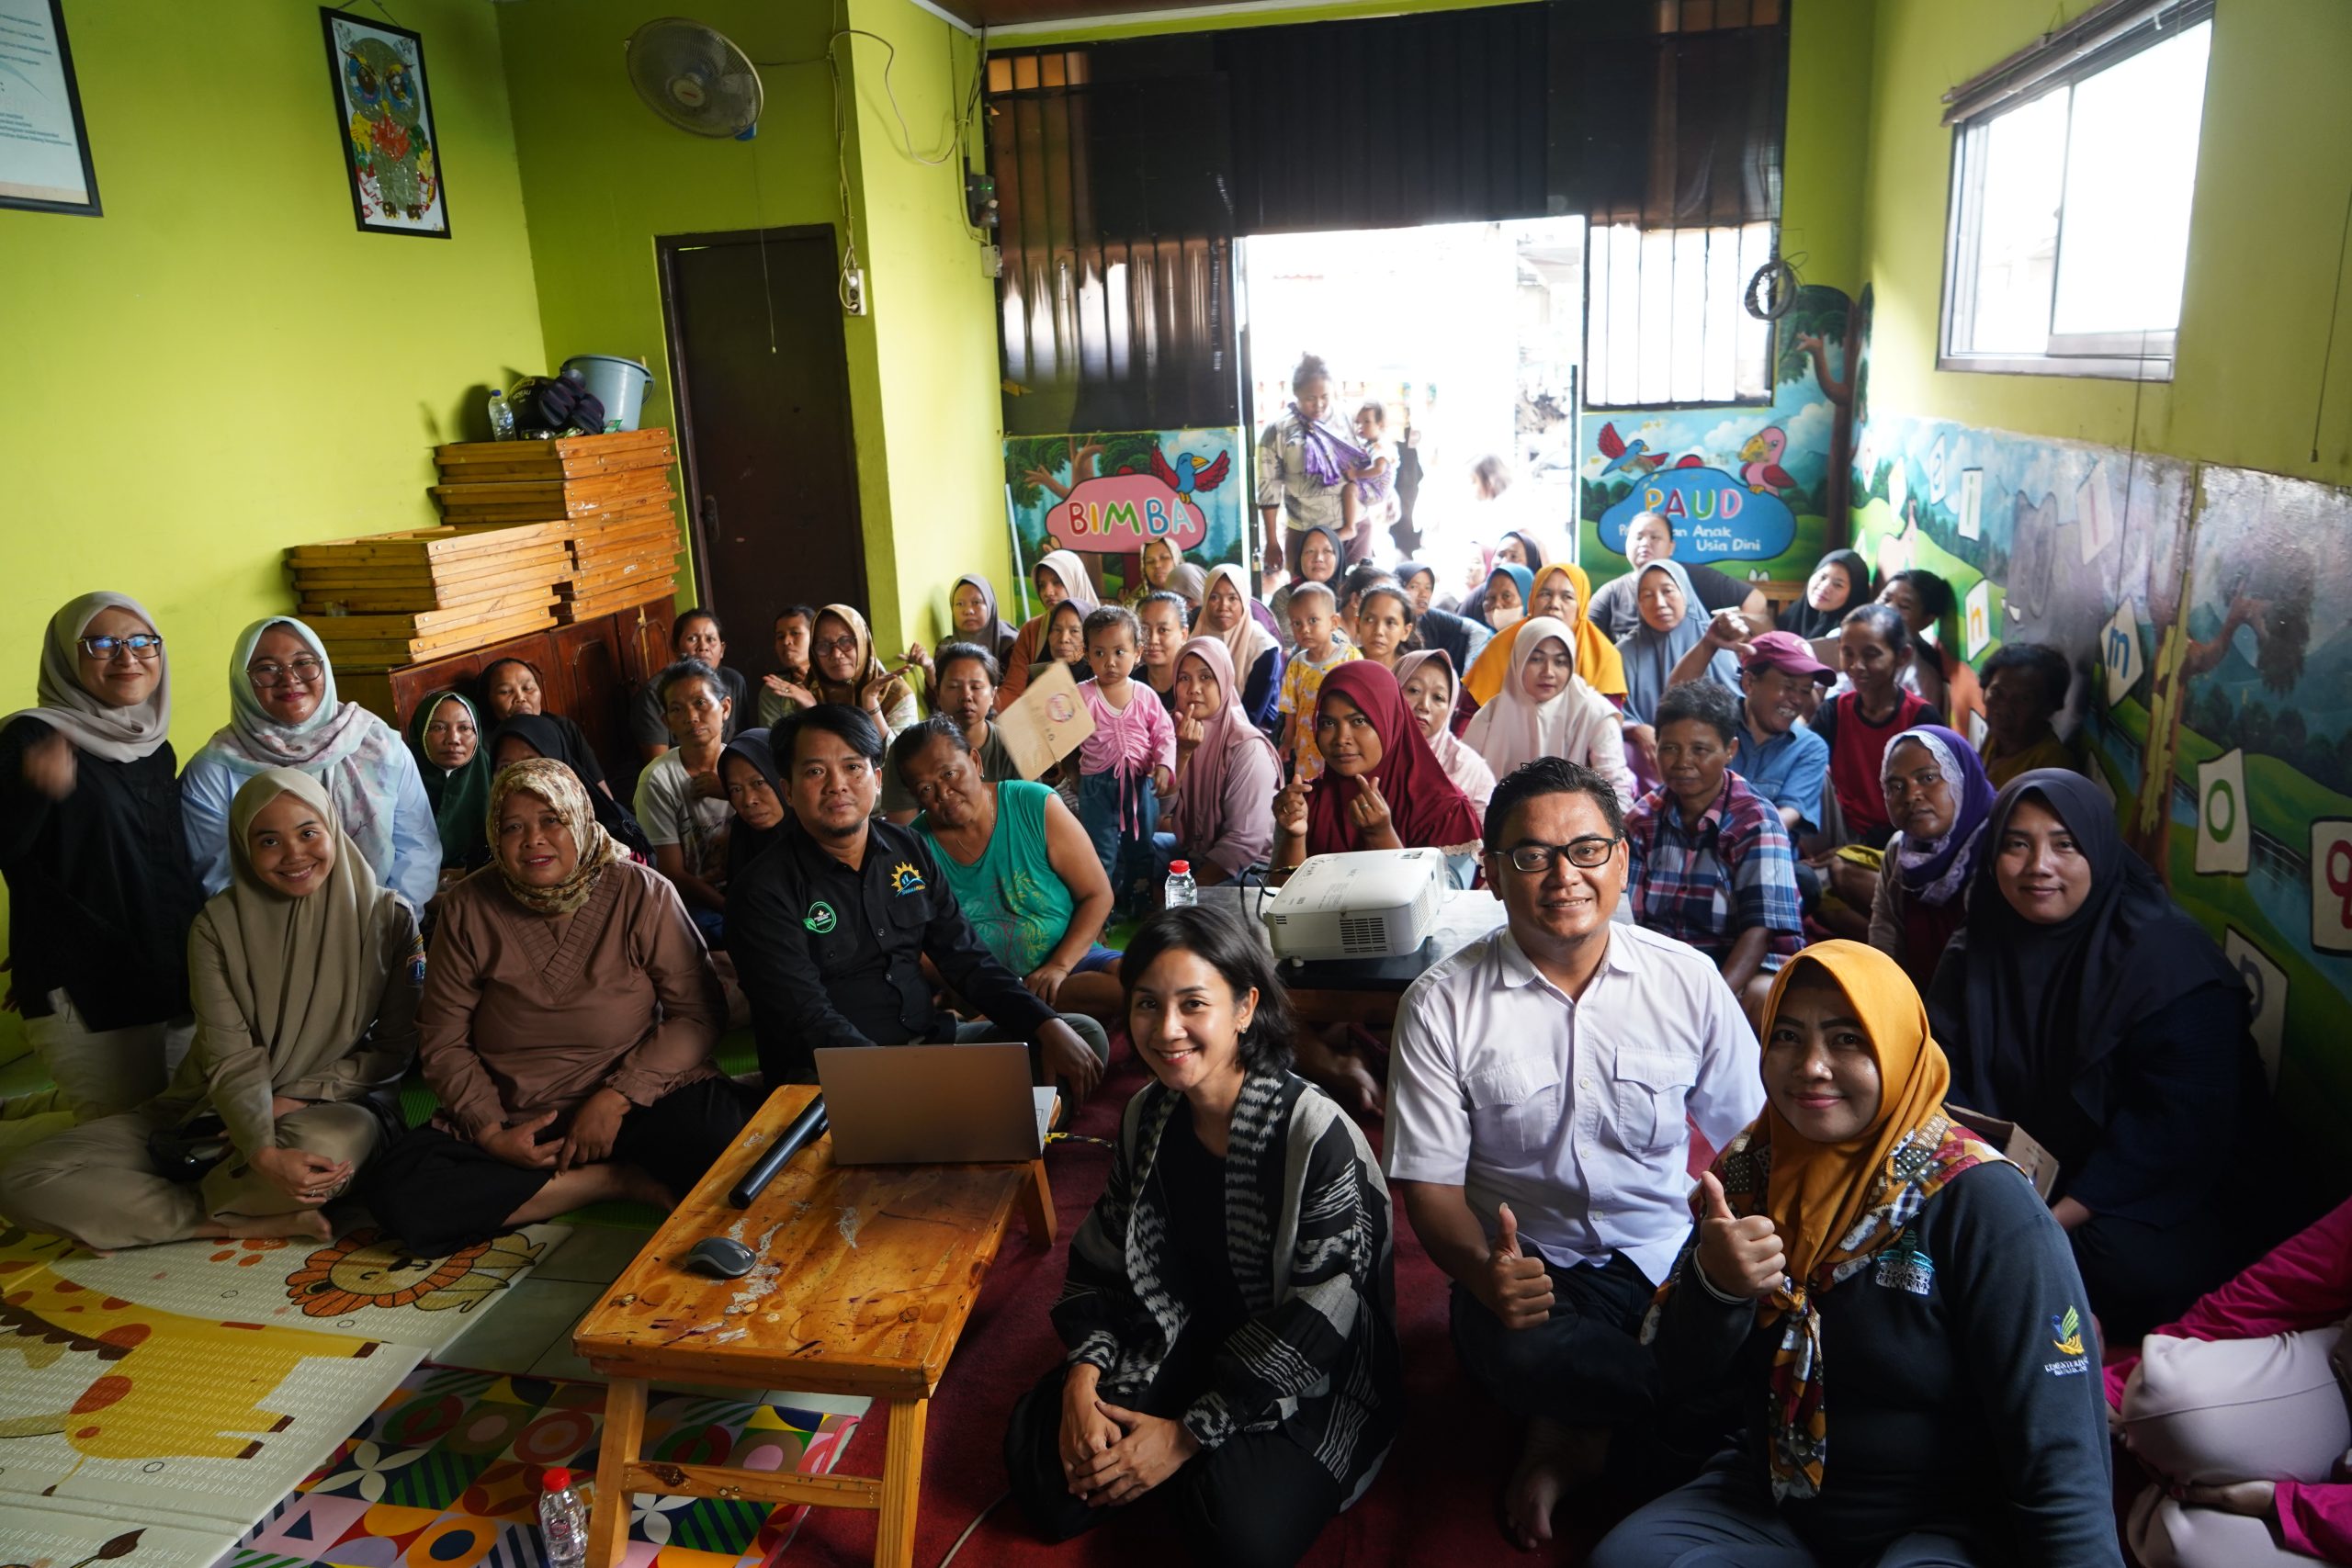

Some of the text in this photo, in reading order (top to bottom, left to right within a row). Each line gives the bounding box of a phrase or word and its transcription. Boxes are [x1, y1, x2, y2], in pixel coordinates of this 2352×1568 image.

[1068, 498, 1195, 536] BIMBA
[1645, 487, 1743, 521] PAUD
[1692, 525, 1733, 538] Anak
[1696, 539, 1761, 552] Usia Dini
[1969, 603, 1984, 643] n
[2108, 626, 2131, 681] m
[2206, 778, 2235, 843] o
